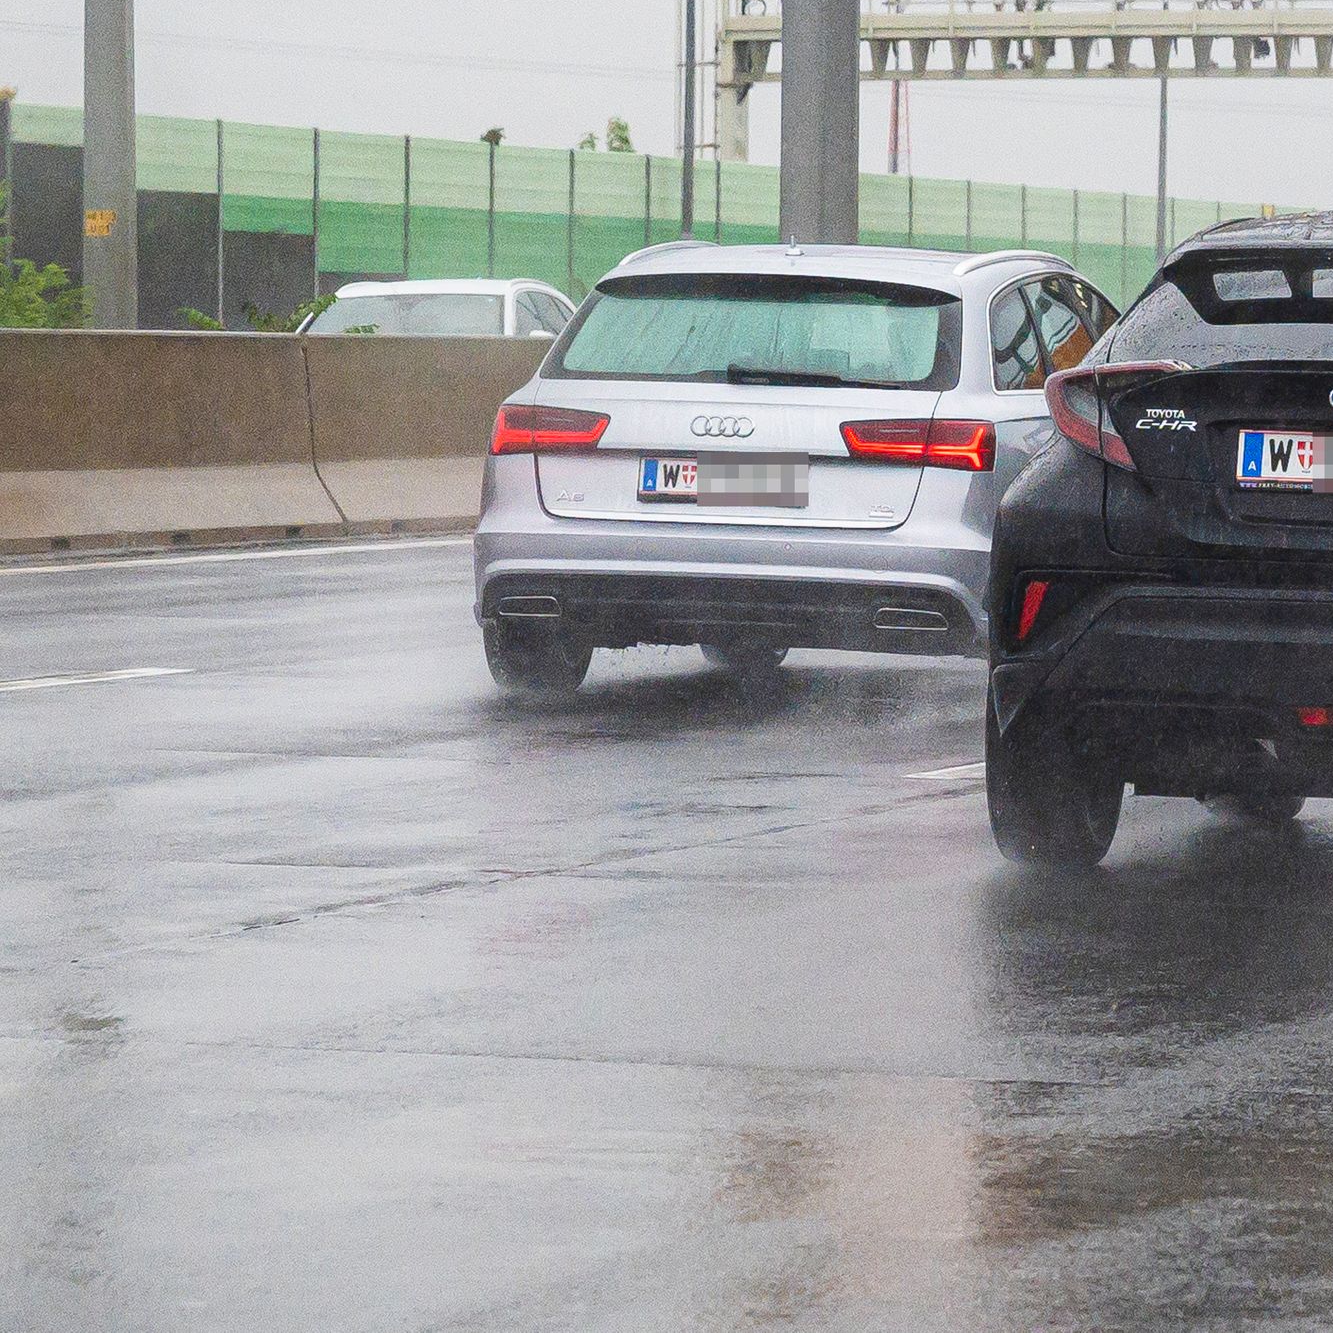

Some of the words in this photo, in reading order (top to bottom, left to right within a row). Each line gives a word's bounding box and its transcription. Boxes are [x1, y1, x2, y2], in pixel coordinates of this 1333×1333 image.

[1145, 408, 1186, 419] TOYOTA
[1135, 419, 1198, 432] C-HR
[1247, 460, 1257, 471] A
[1269, 438, 1294, 473] W
[662, 463, 681, 489] W
